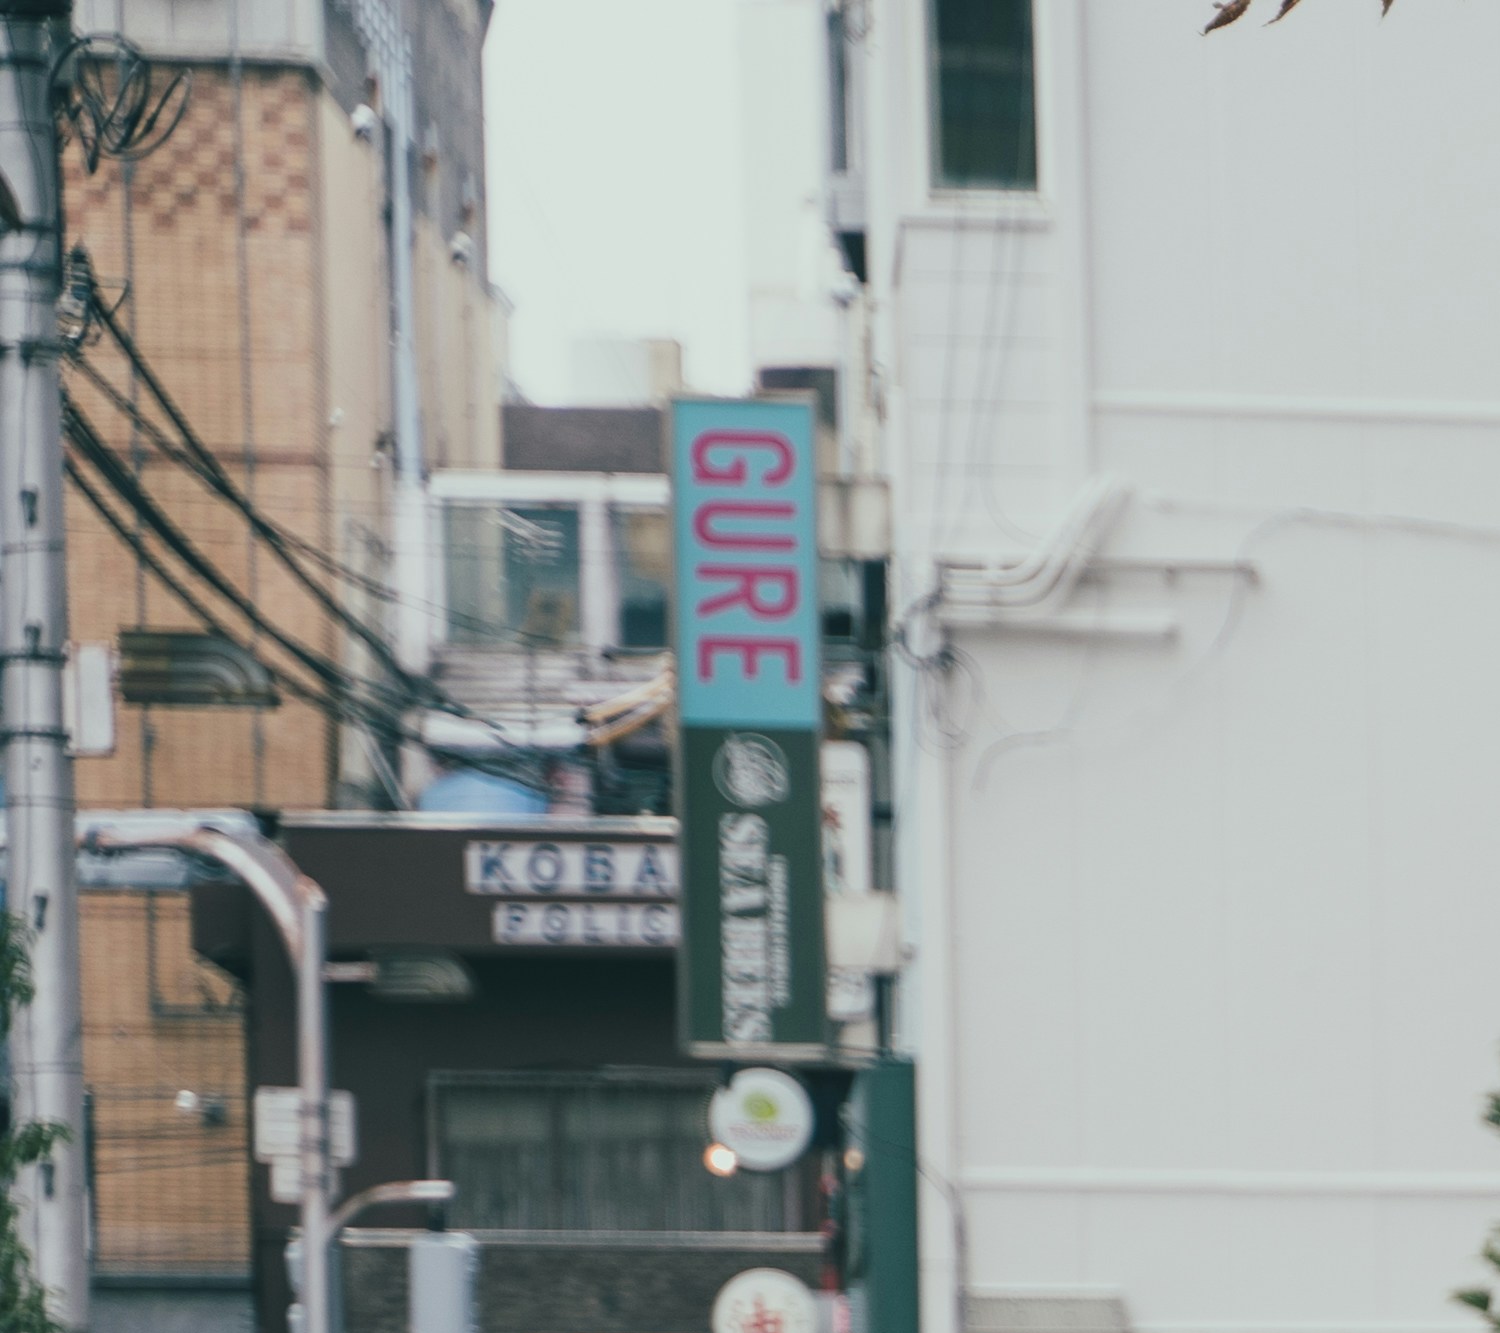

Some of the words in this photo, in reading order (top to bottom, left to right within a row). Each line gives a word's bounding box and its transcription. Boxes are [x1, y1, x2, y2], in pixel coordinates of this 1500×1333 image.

[690, 429, 802, 683] GURE
[479, 841, 674, 896] KOBA
[502, 902, 674, 944] POLIC
